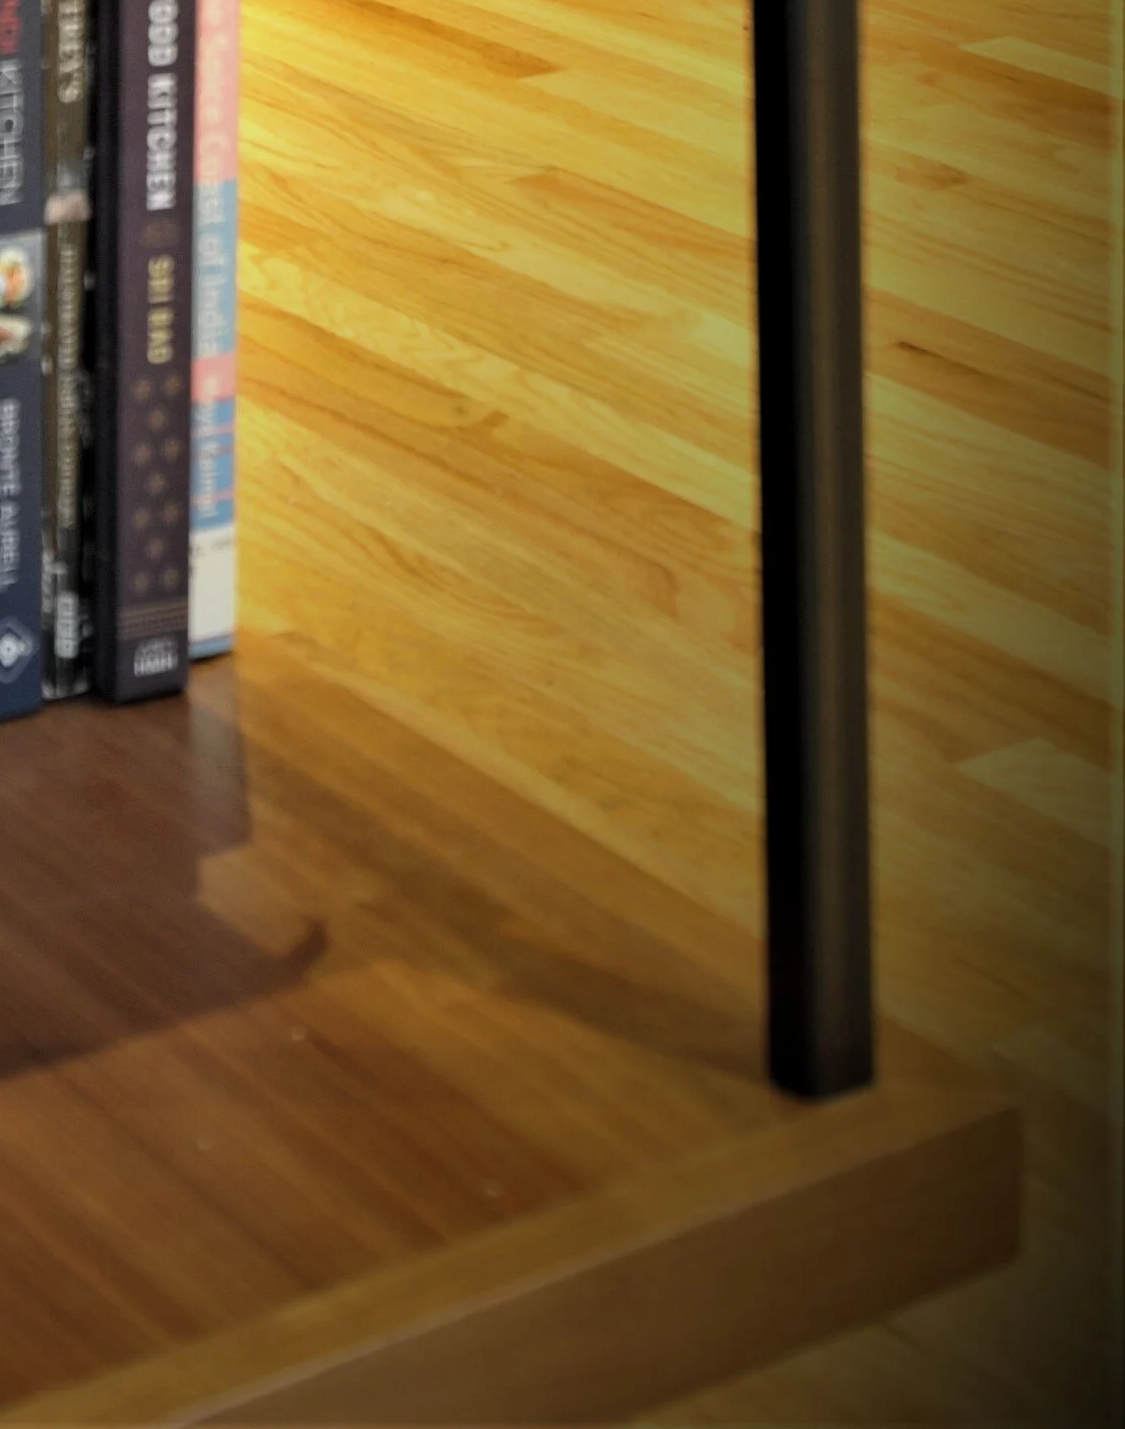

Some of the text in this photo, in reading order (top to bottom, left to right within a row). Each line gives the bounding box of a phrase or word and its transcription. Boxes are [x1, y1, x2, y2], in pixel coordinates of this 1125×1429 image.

[145, 73, 178, 213] KITCHEN
[202, 234, 228, 266] of
[145, 253, 175, 366] SRI RAO
[195, 282, 228, 360] India
